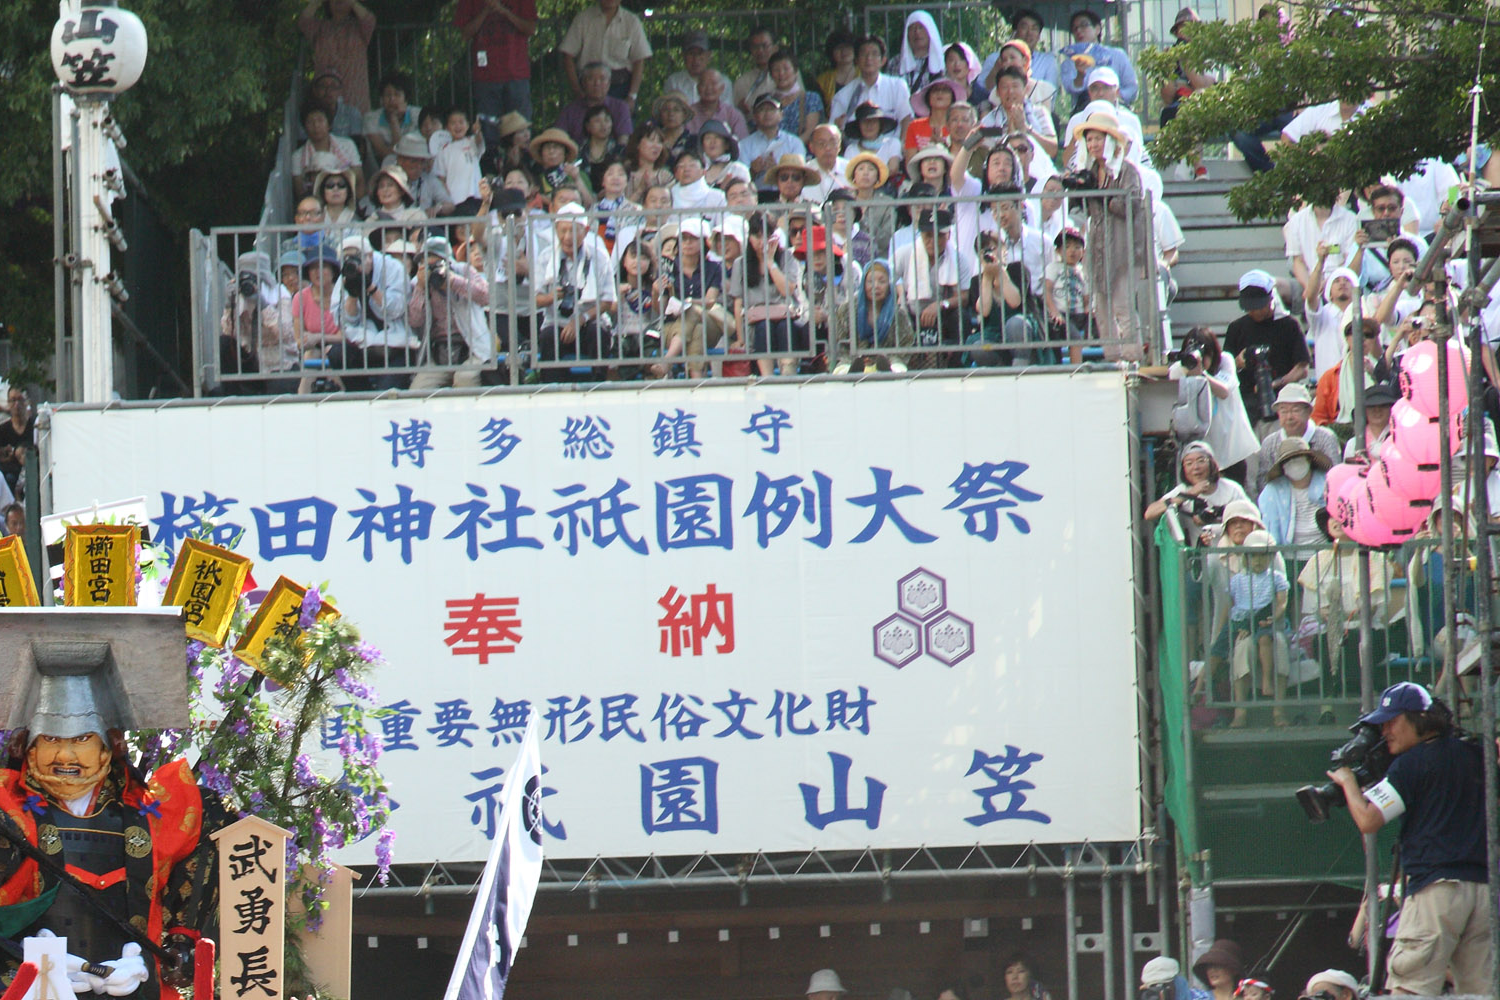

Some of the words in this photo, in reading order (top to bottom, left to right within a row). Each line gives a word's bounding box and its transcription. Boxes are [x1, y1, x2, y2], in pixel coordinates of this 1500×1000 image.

[61, 10, 119, 88] 山笠
[381, 404, 793, 469] 博多総鎮守
[85, 535, 114, 603] 櫛田宮
